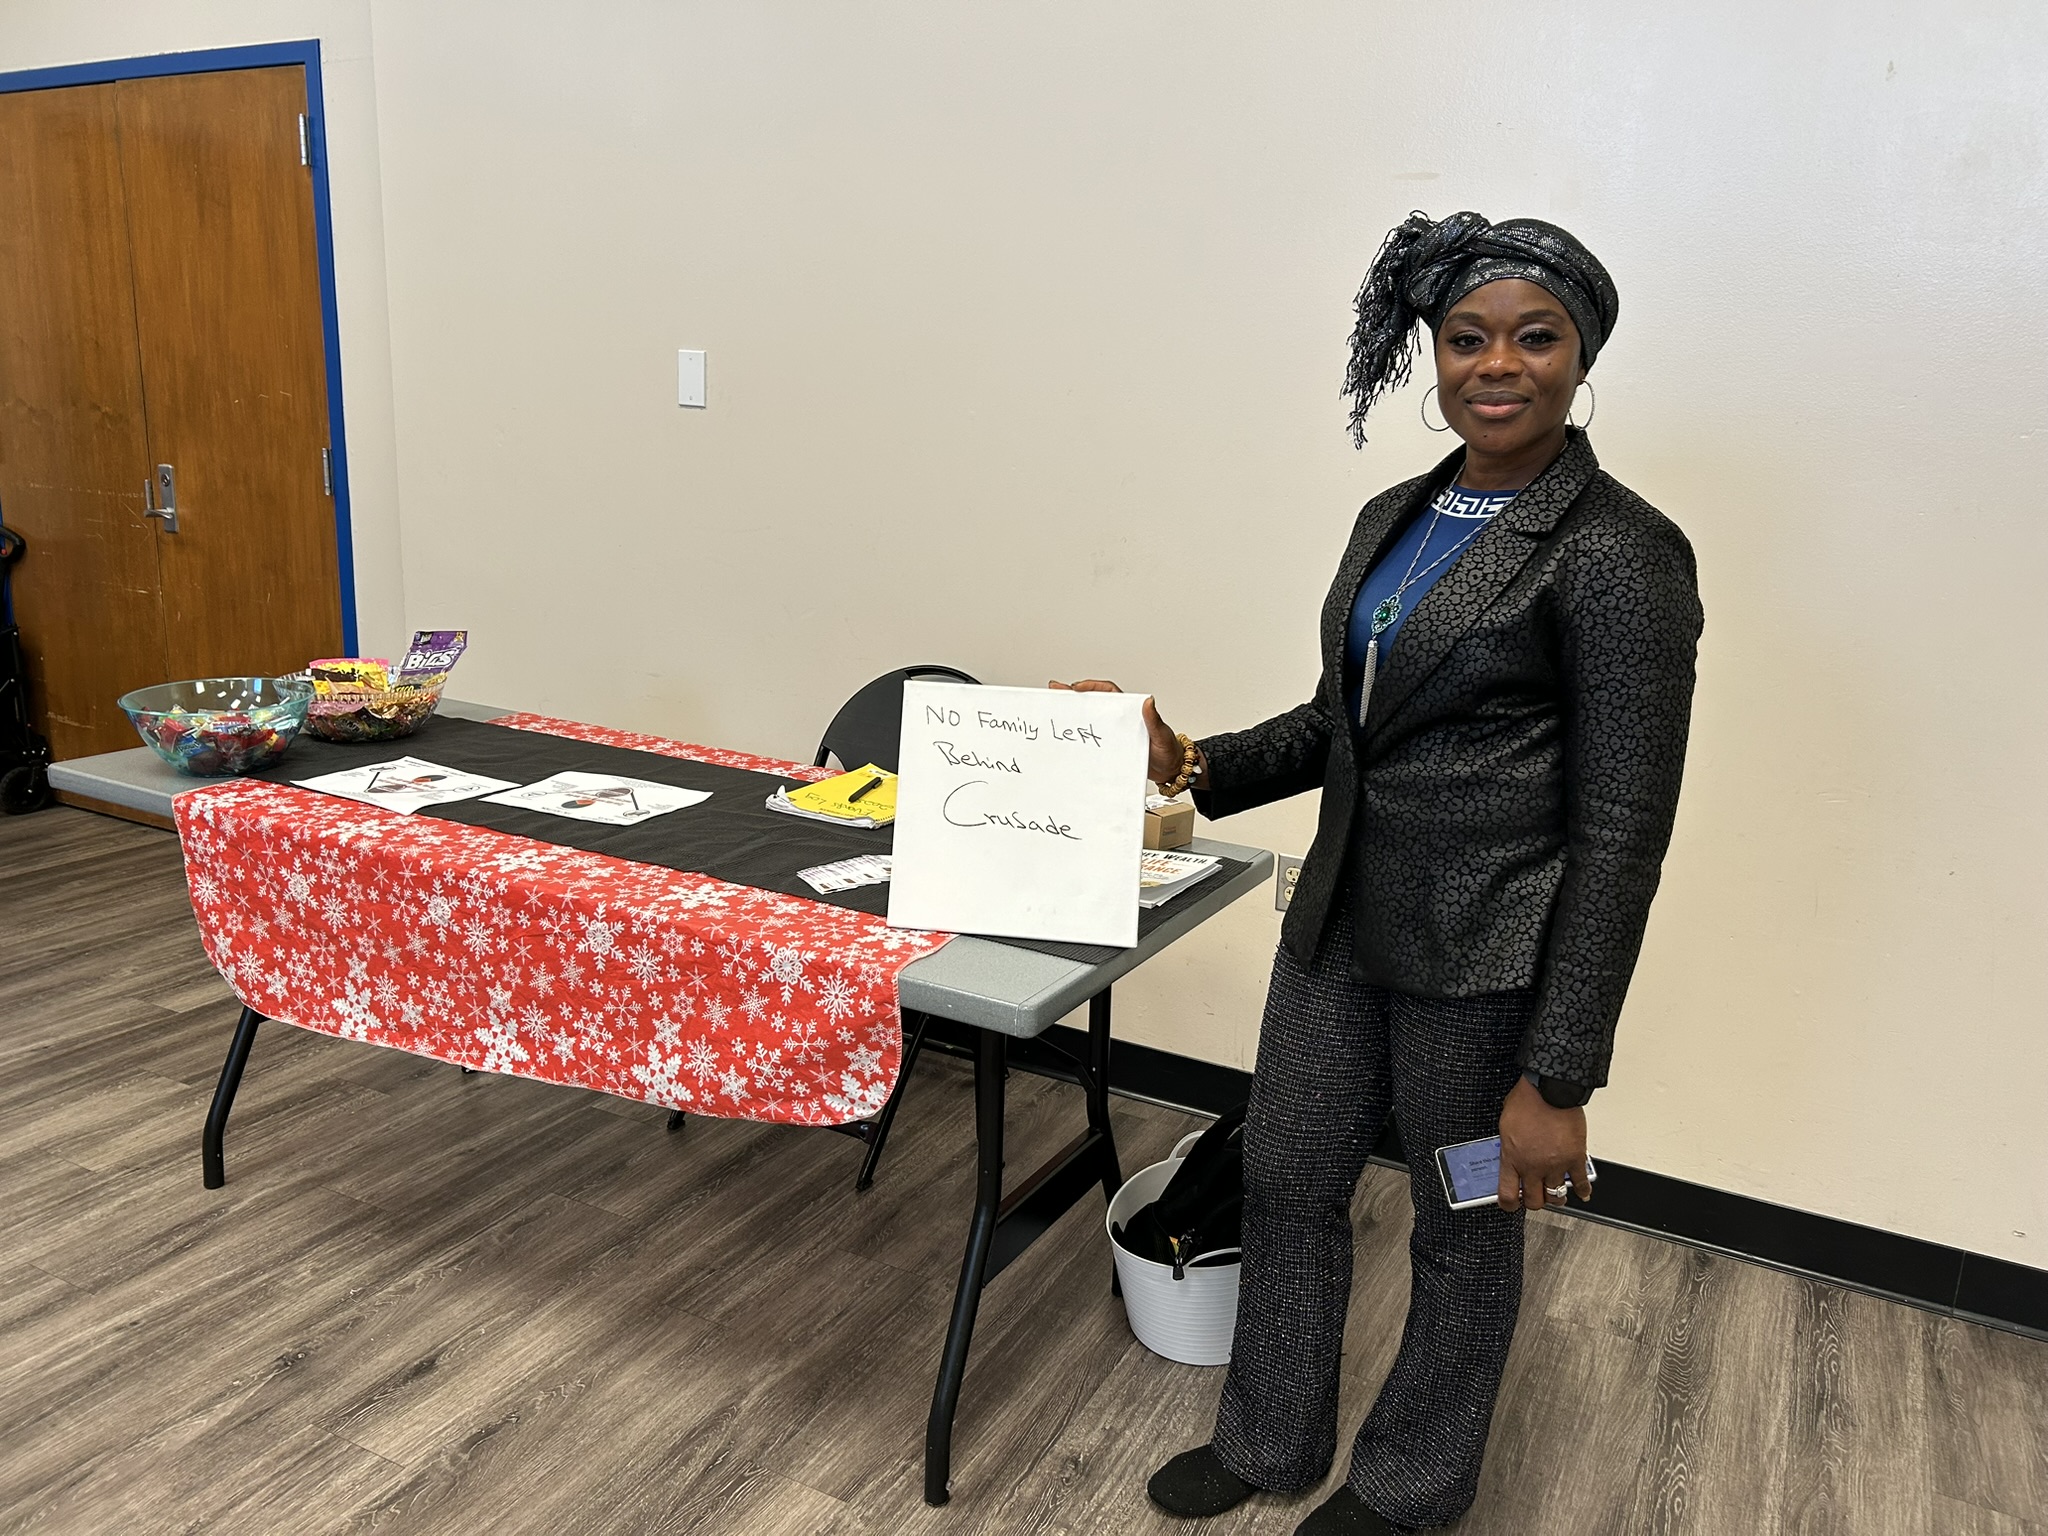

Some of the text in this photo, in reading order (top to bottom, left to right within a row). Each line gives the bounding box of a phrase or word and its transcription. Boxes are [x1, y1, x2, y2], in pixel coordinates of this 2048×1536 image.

[977, 711, 1039, 741] Family
[932, 740, 1023, 774] Behind
[942, 780, 1083, 841] Crusade
[1163, 853, 1208, 864] WEALTH.
